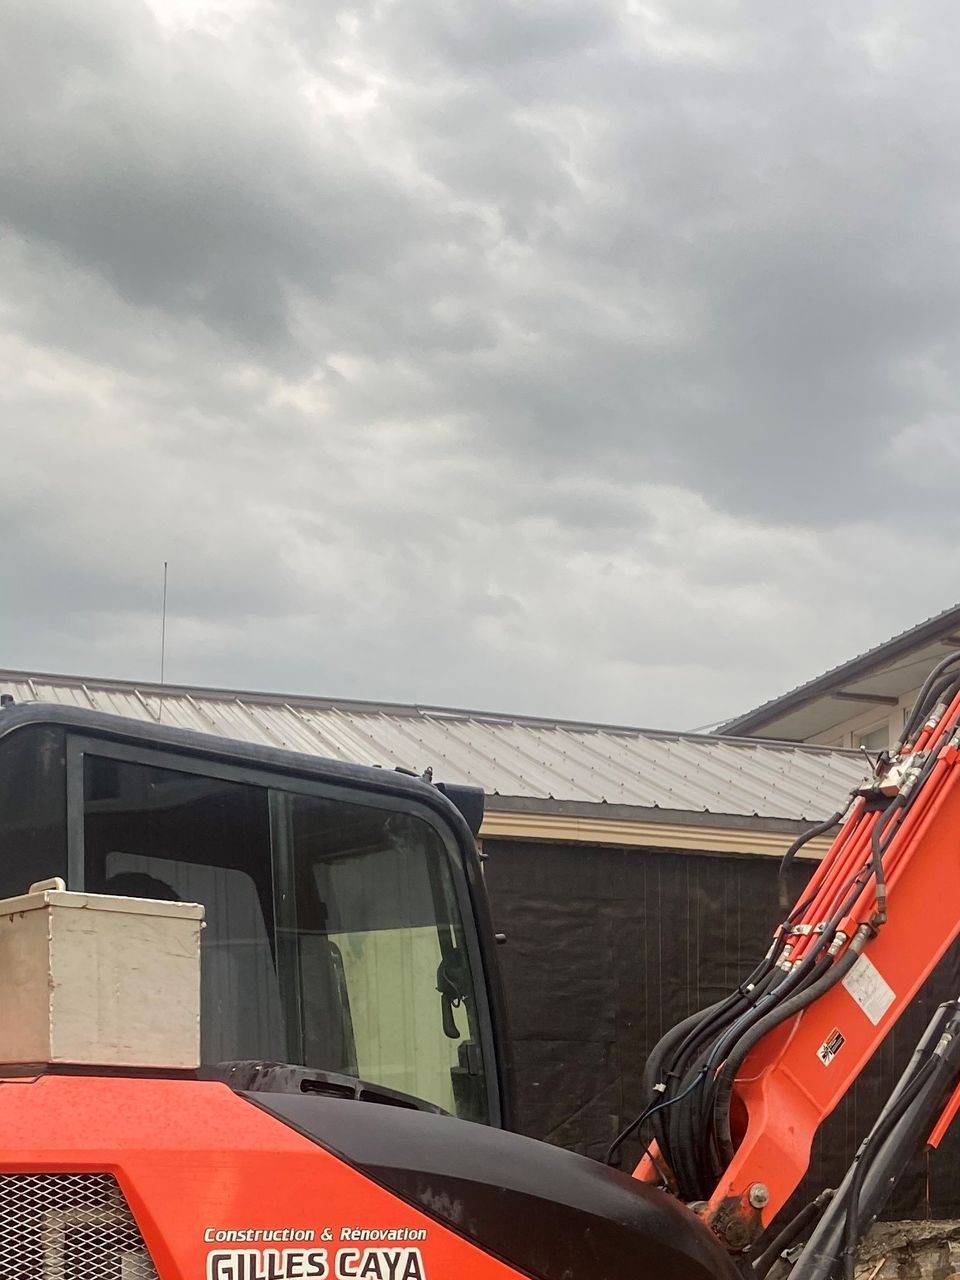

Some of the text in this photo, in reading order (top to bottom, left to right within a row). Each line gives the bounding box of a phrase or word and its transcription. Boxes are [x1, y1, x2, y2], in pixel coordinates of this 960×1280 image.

[204, 1225, 427, 1243] Construction & Rénovation
